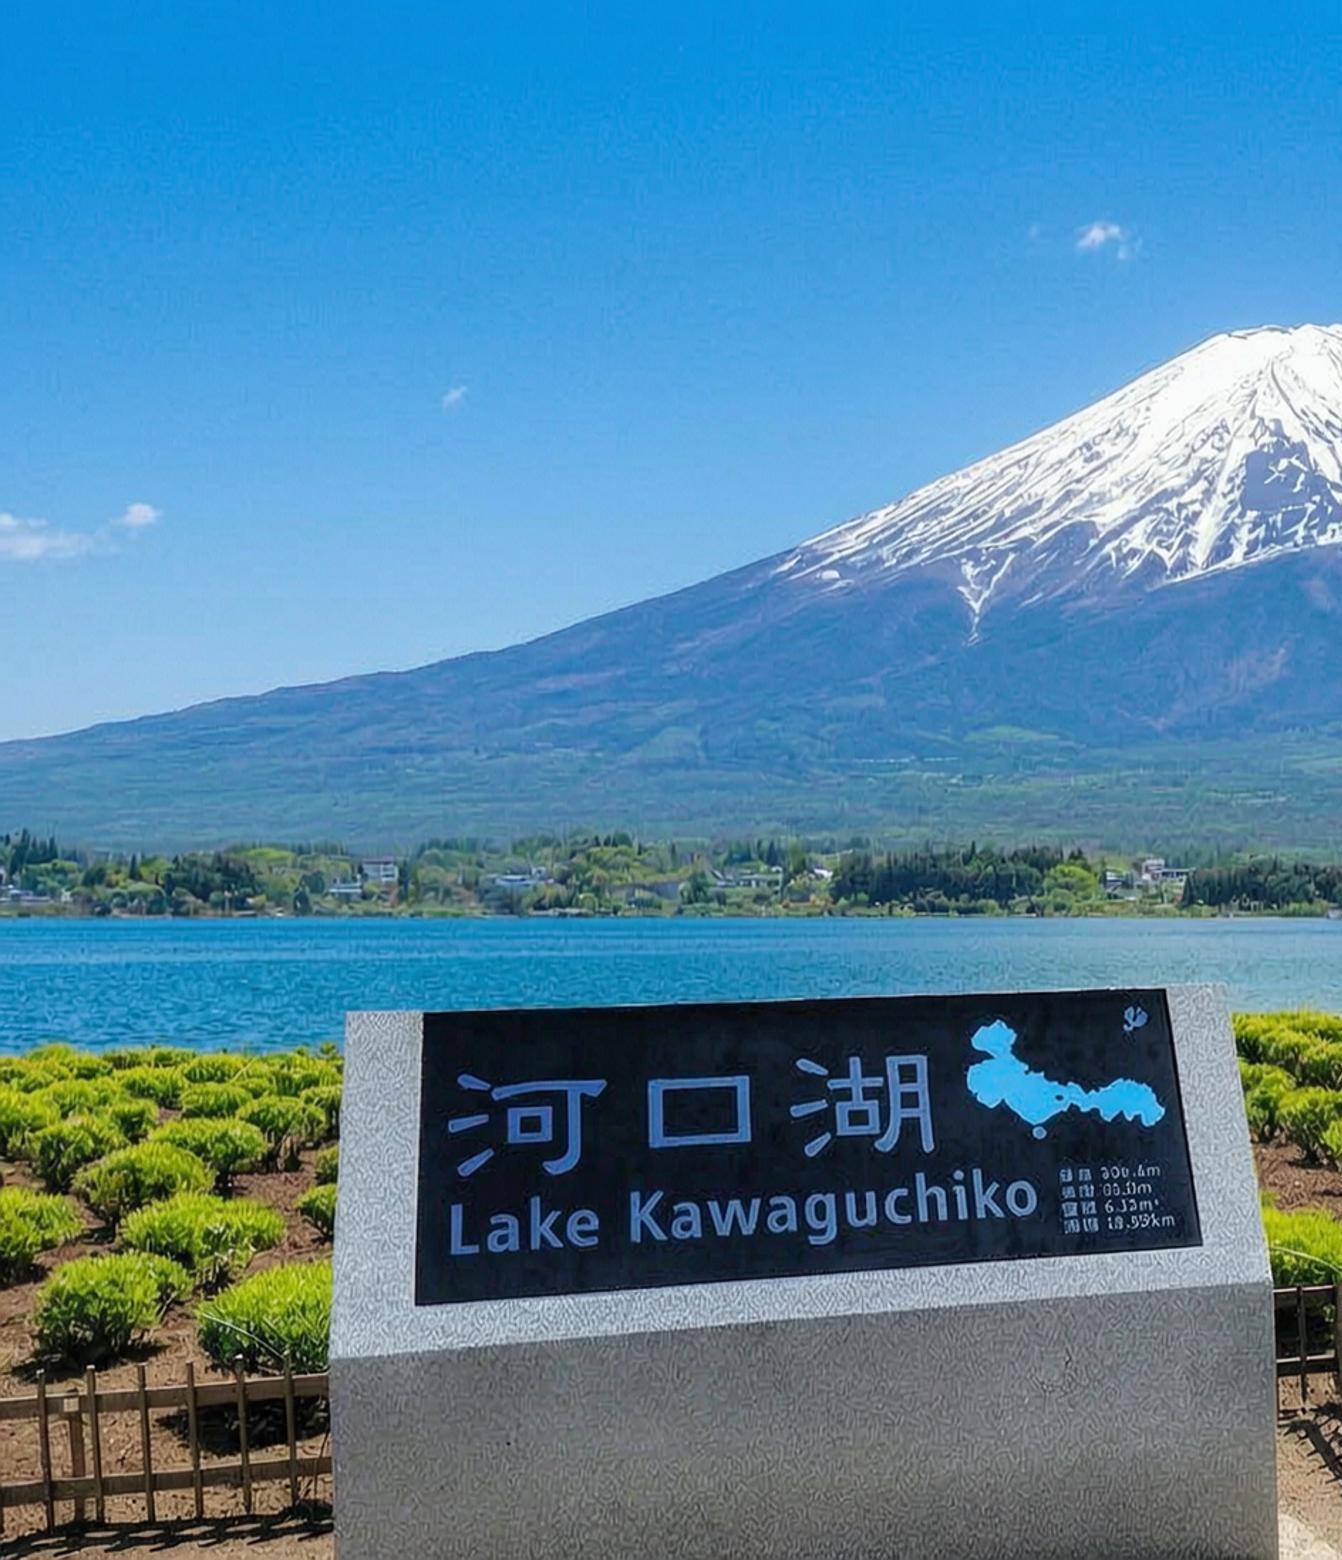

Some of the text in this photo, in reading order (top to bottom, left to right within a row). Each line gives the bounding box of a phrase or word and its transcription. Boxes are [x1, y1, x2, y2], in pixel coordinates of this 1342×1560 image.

[448, 1054, 935, 1177] 河口湖
[451, 1168, 1038, 1255] Lake Kawaguchiko
